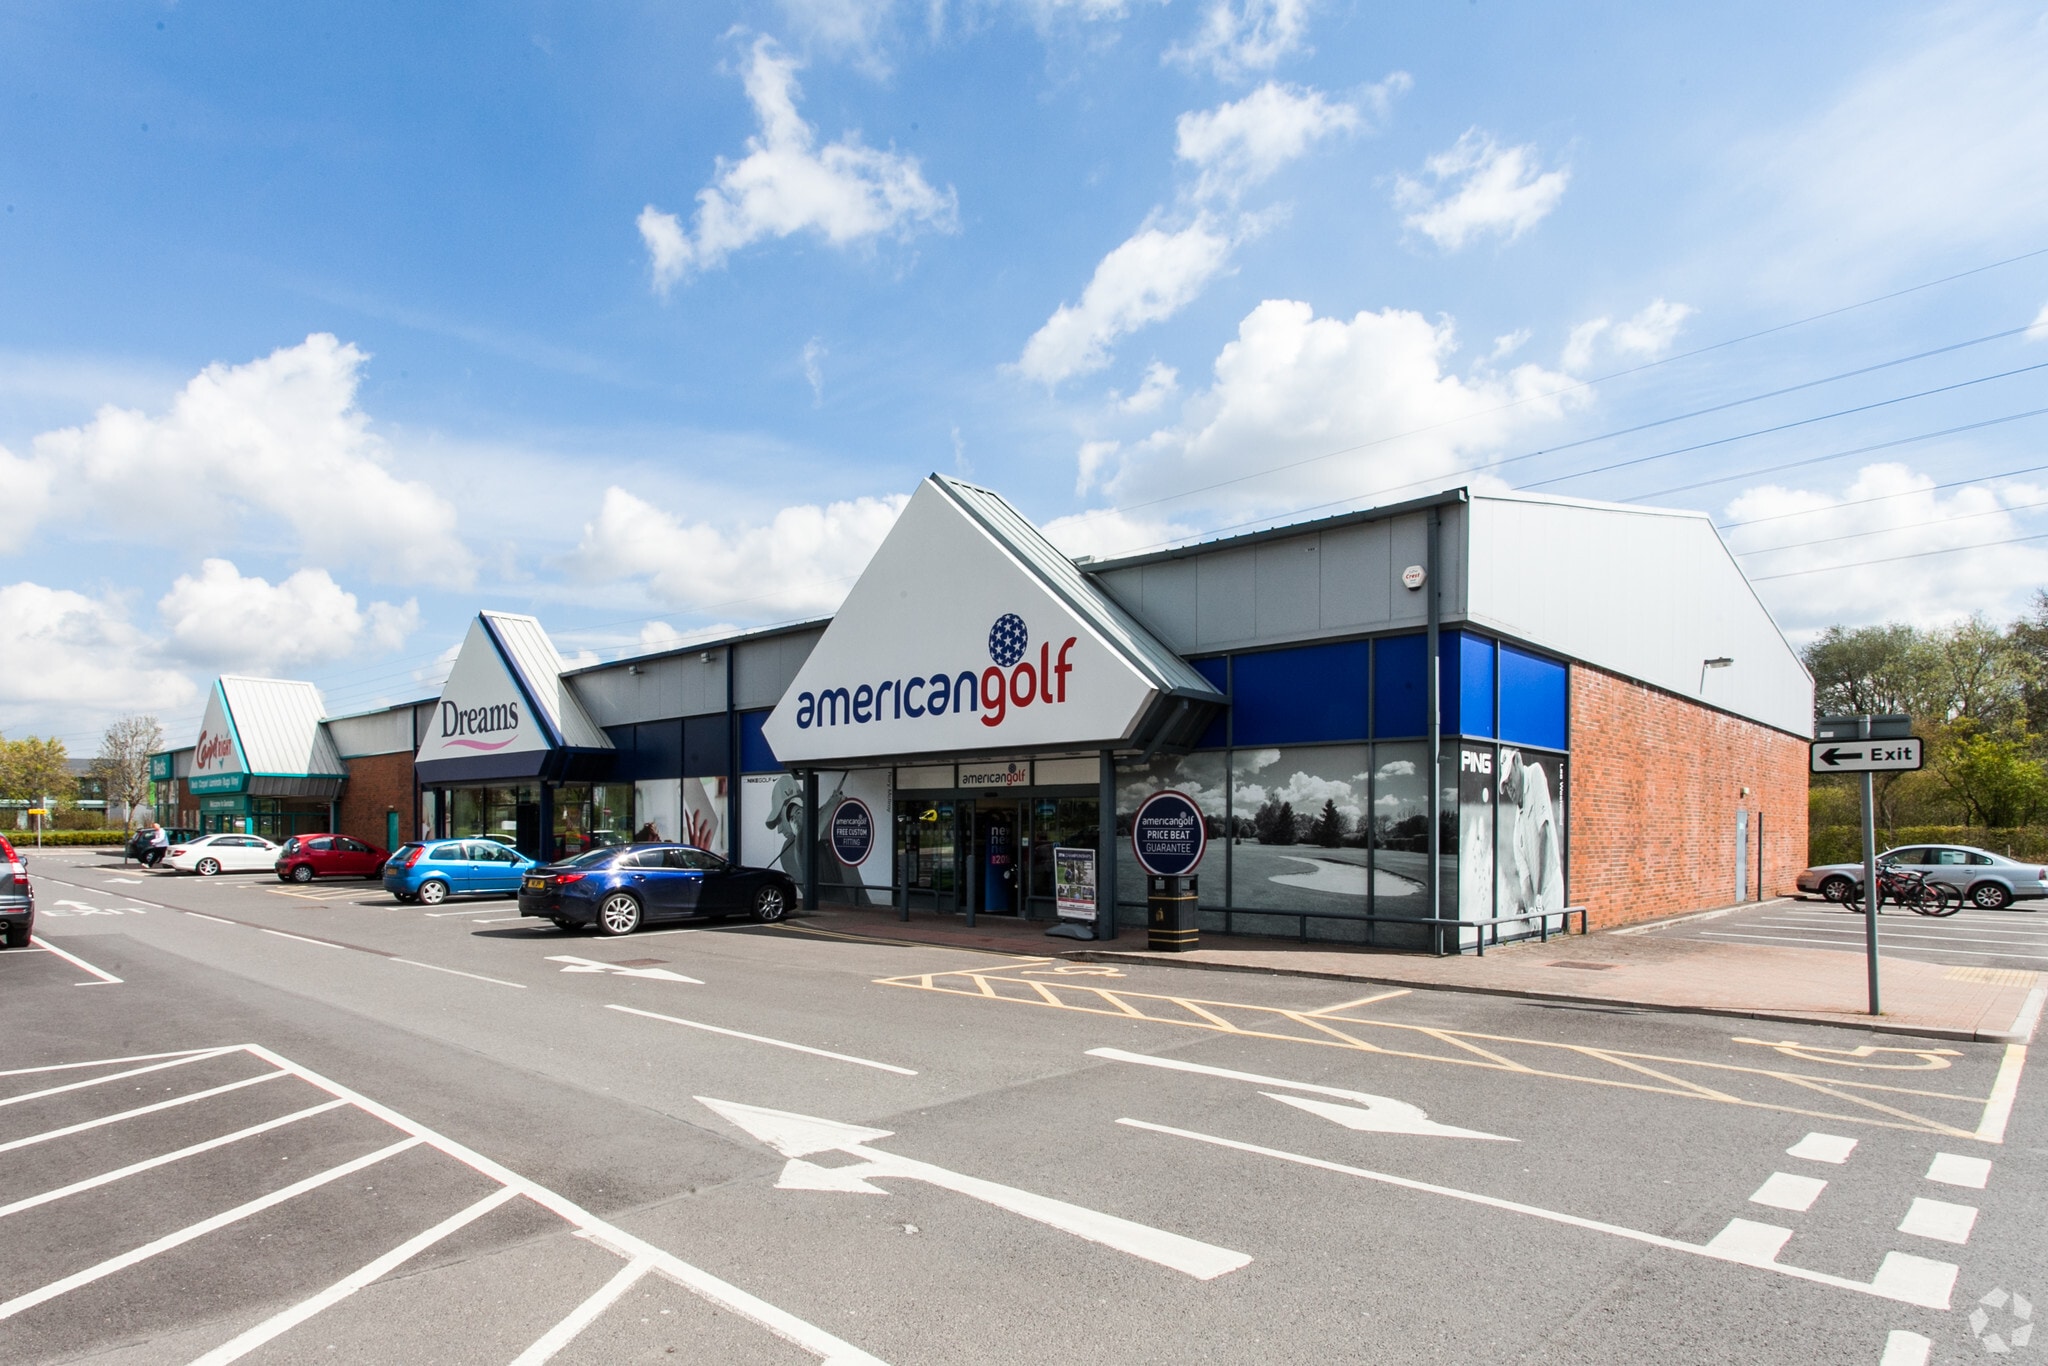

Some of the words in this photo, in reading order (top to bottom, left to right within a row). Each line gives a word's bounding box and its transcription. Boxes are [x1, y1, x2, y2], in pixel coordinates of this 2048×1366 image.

[796, 636, 1077, 729] americangolf
[441, 700, 519, 738] Dreams
[1871, 747, 1912, 761] Exit
[153, 759, 166, 776] Beds
[1461, 750, 1492, 774] PING
[962, 769, 1026, 786] americangolf
[836, 817, 867, 827] americangolf
[1142, 815, 1194, 828] americangolf
[836, 828, 848, 836] FREE
[849, 828, 867, 836] CUSTOM
[1147, 830, 1169, 839] PRICE
[1170, 830, 1190, 840] BEAT
[843, 838, 860, 846] FITTING
[1146, 842, 1191, 853] GUARANTEE
[40, 907, 147, 917] EXIT
